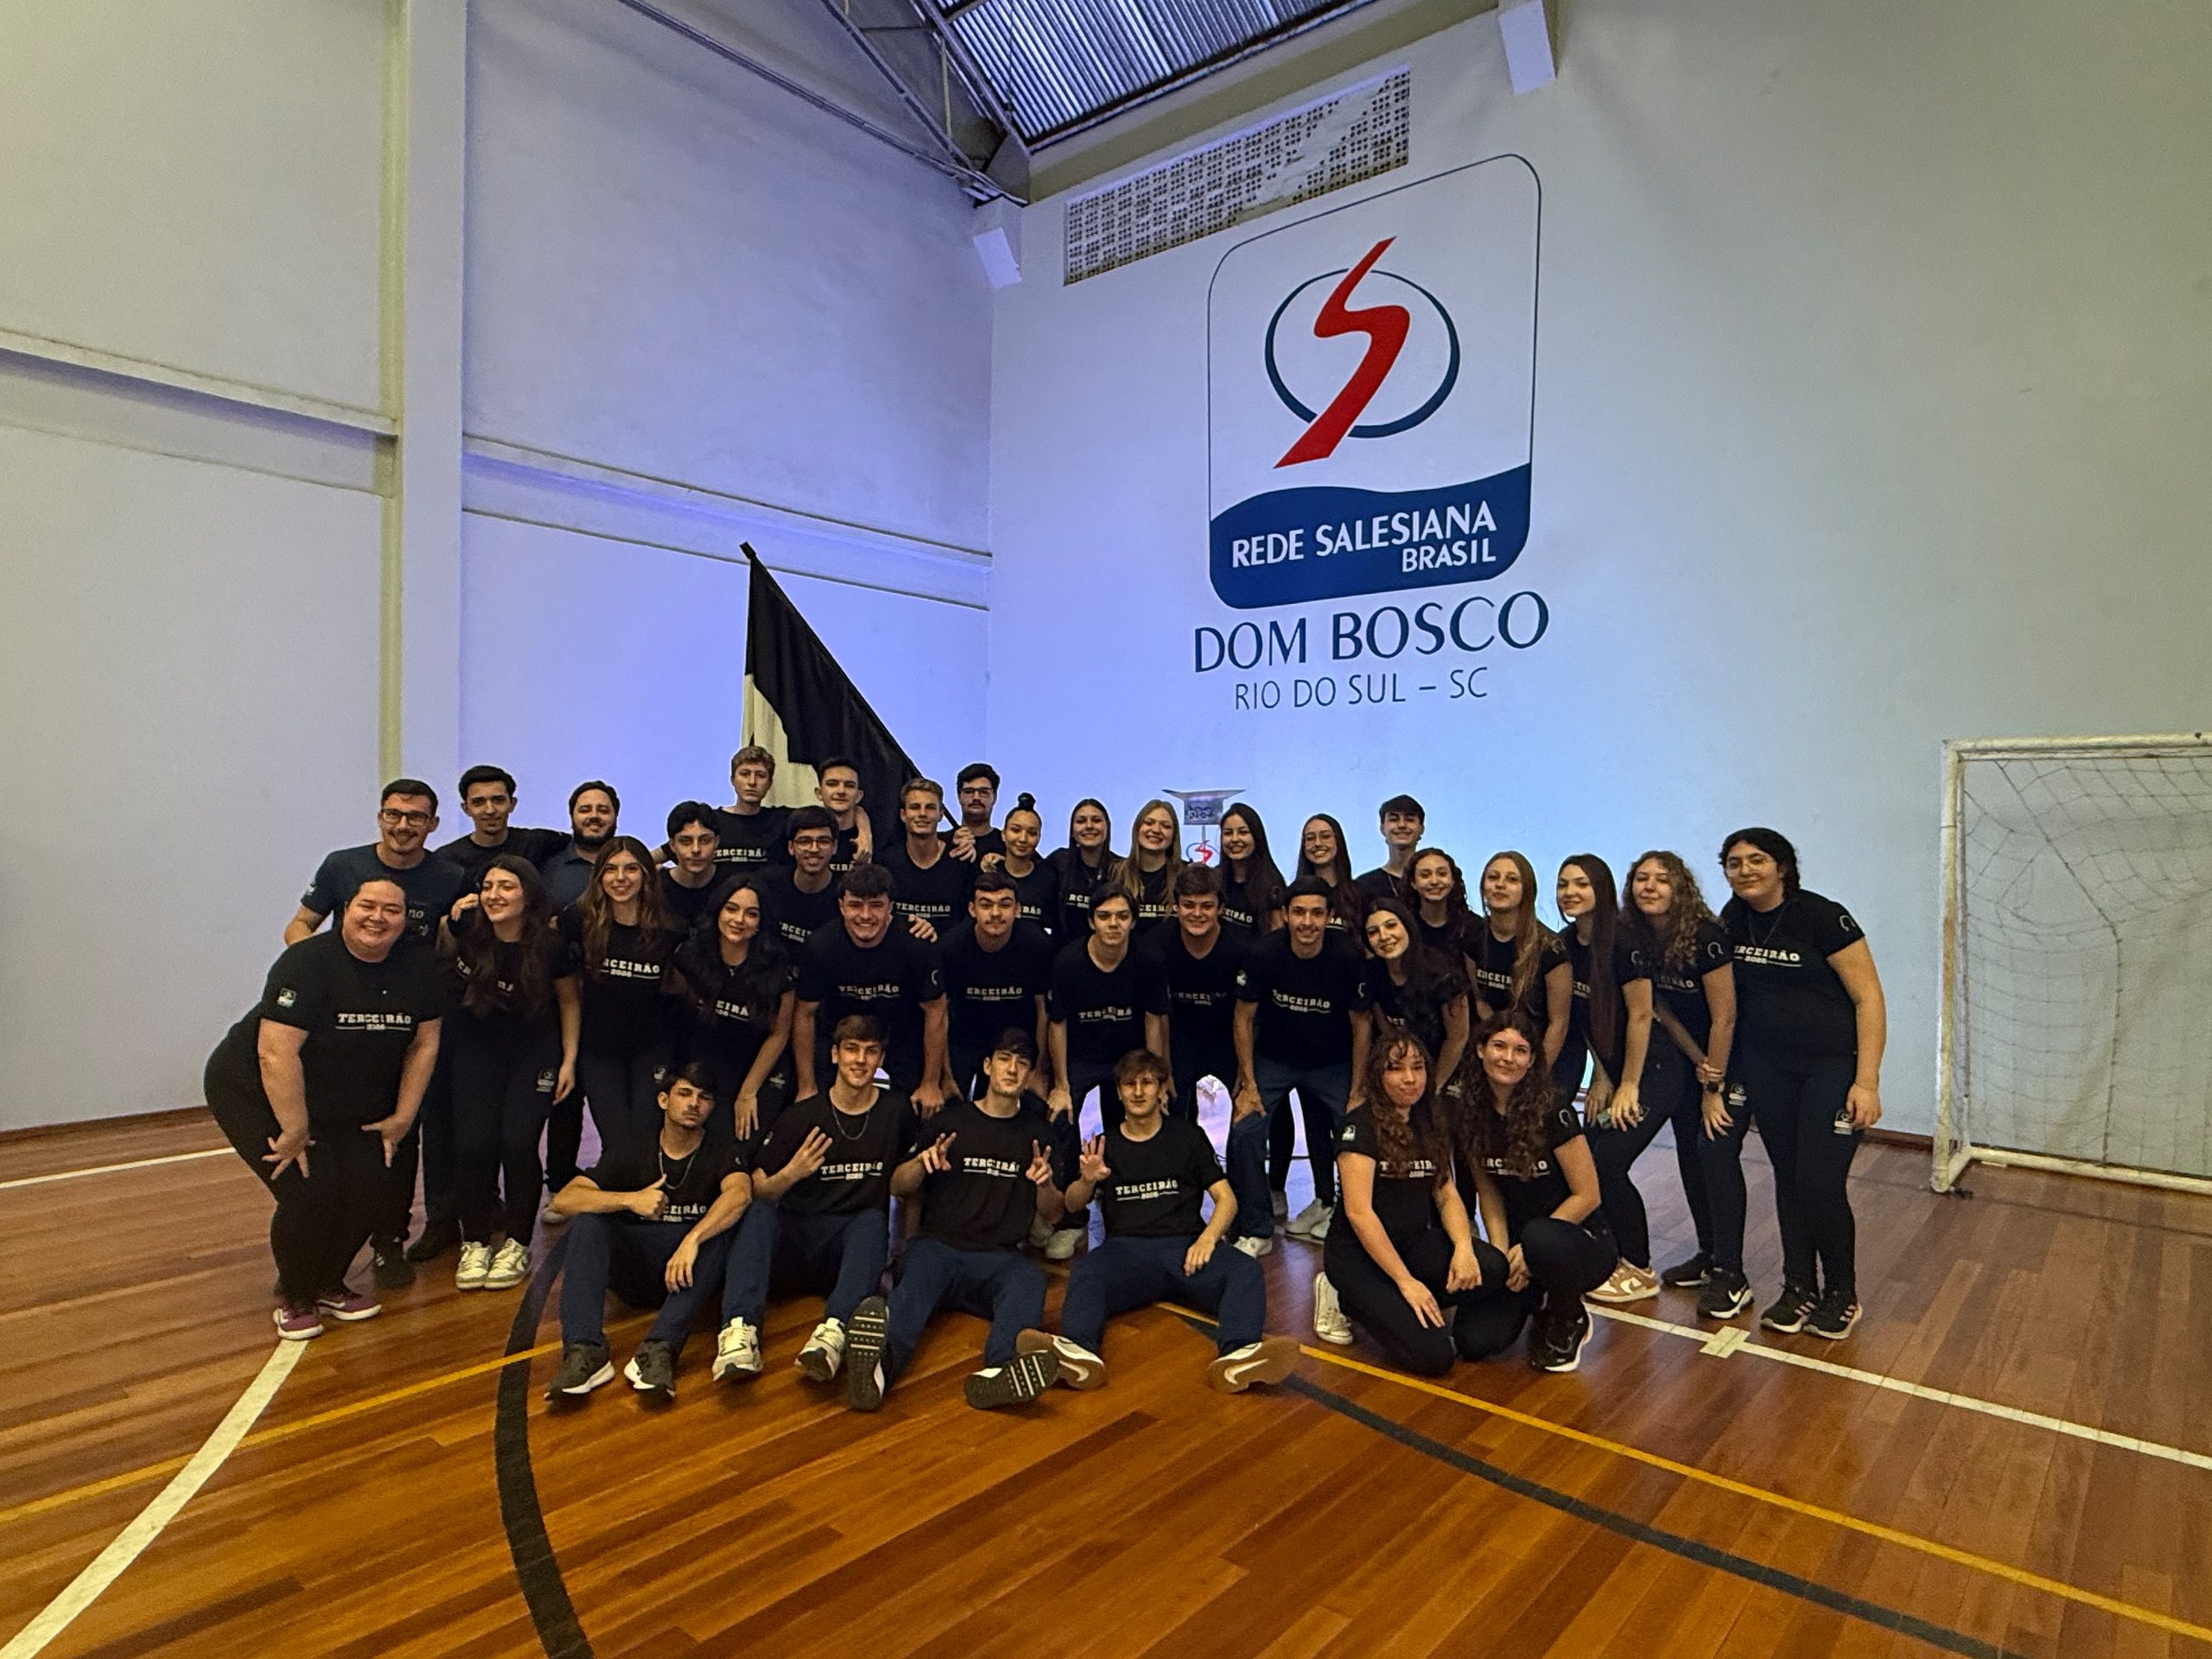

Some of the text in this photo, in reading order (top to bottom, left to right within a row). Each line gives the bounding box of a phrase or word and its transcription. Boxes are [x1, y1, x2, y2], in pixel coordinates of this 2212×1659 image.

[1232, 500, 1497, 568] REDE SALESIANA
[1402, 537, 1497, 573] BRASIL
[1194, 591, 1549, 672] DOM BOSCO
[1236, 680, 1281, 709] RIO
[1294, 677, 1336, 708] DO
[1349, 673, 1406, 705] SUL
[1450, 666, 1488, 699] SC
